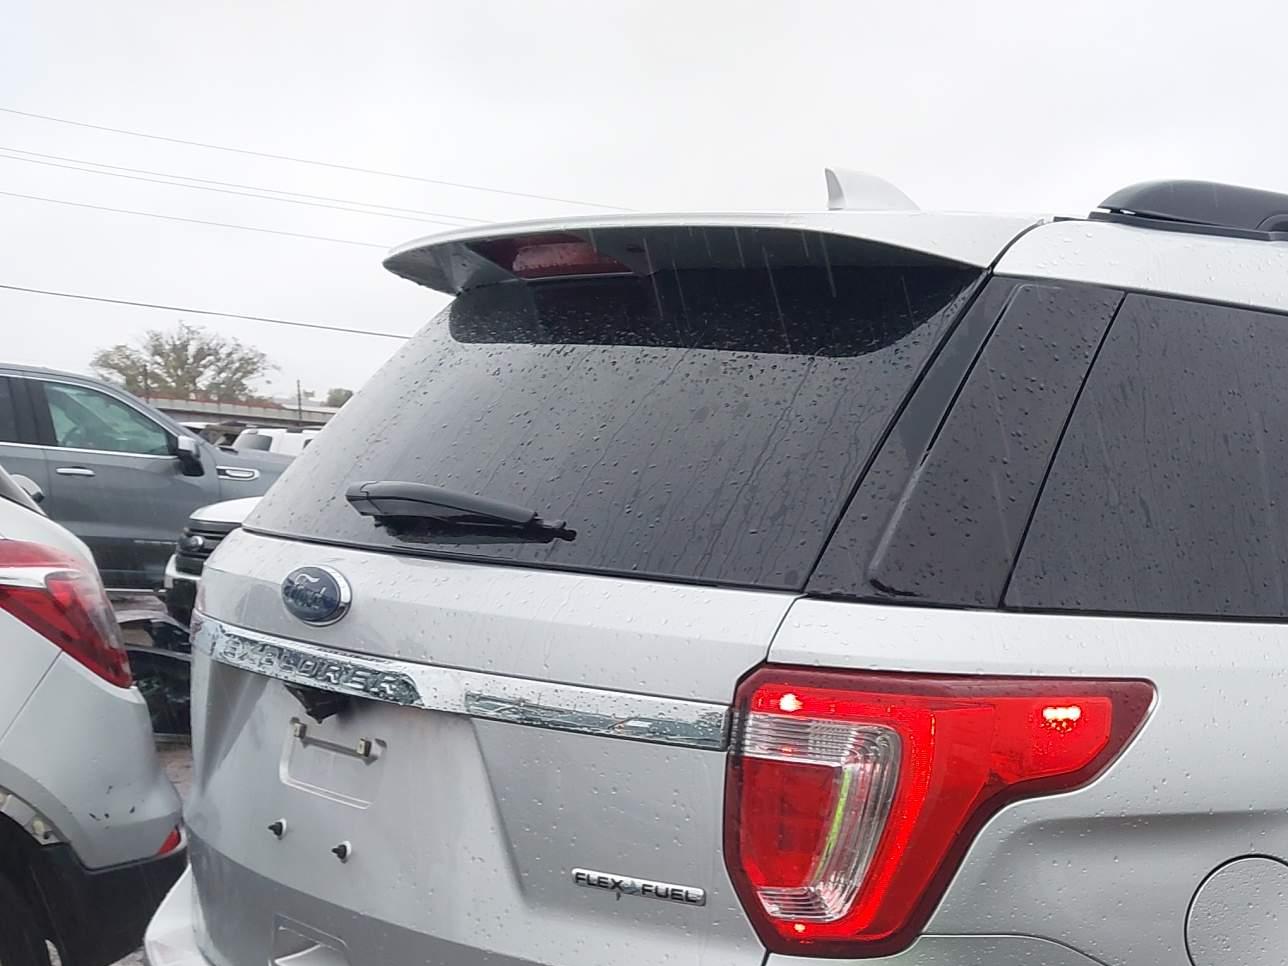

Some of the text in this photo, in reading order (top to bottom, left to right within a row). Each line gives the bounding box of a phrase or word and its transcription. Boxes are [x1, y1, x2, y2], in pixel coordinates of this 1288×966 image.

[283, 573, 336, 611] Ford
[222, 637, 399, 701] EXPLORER
[574, 871, 698, 903] FLEX FUEL
